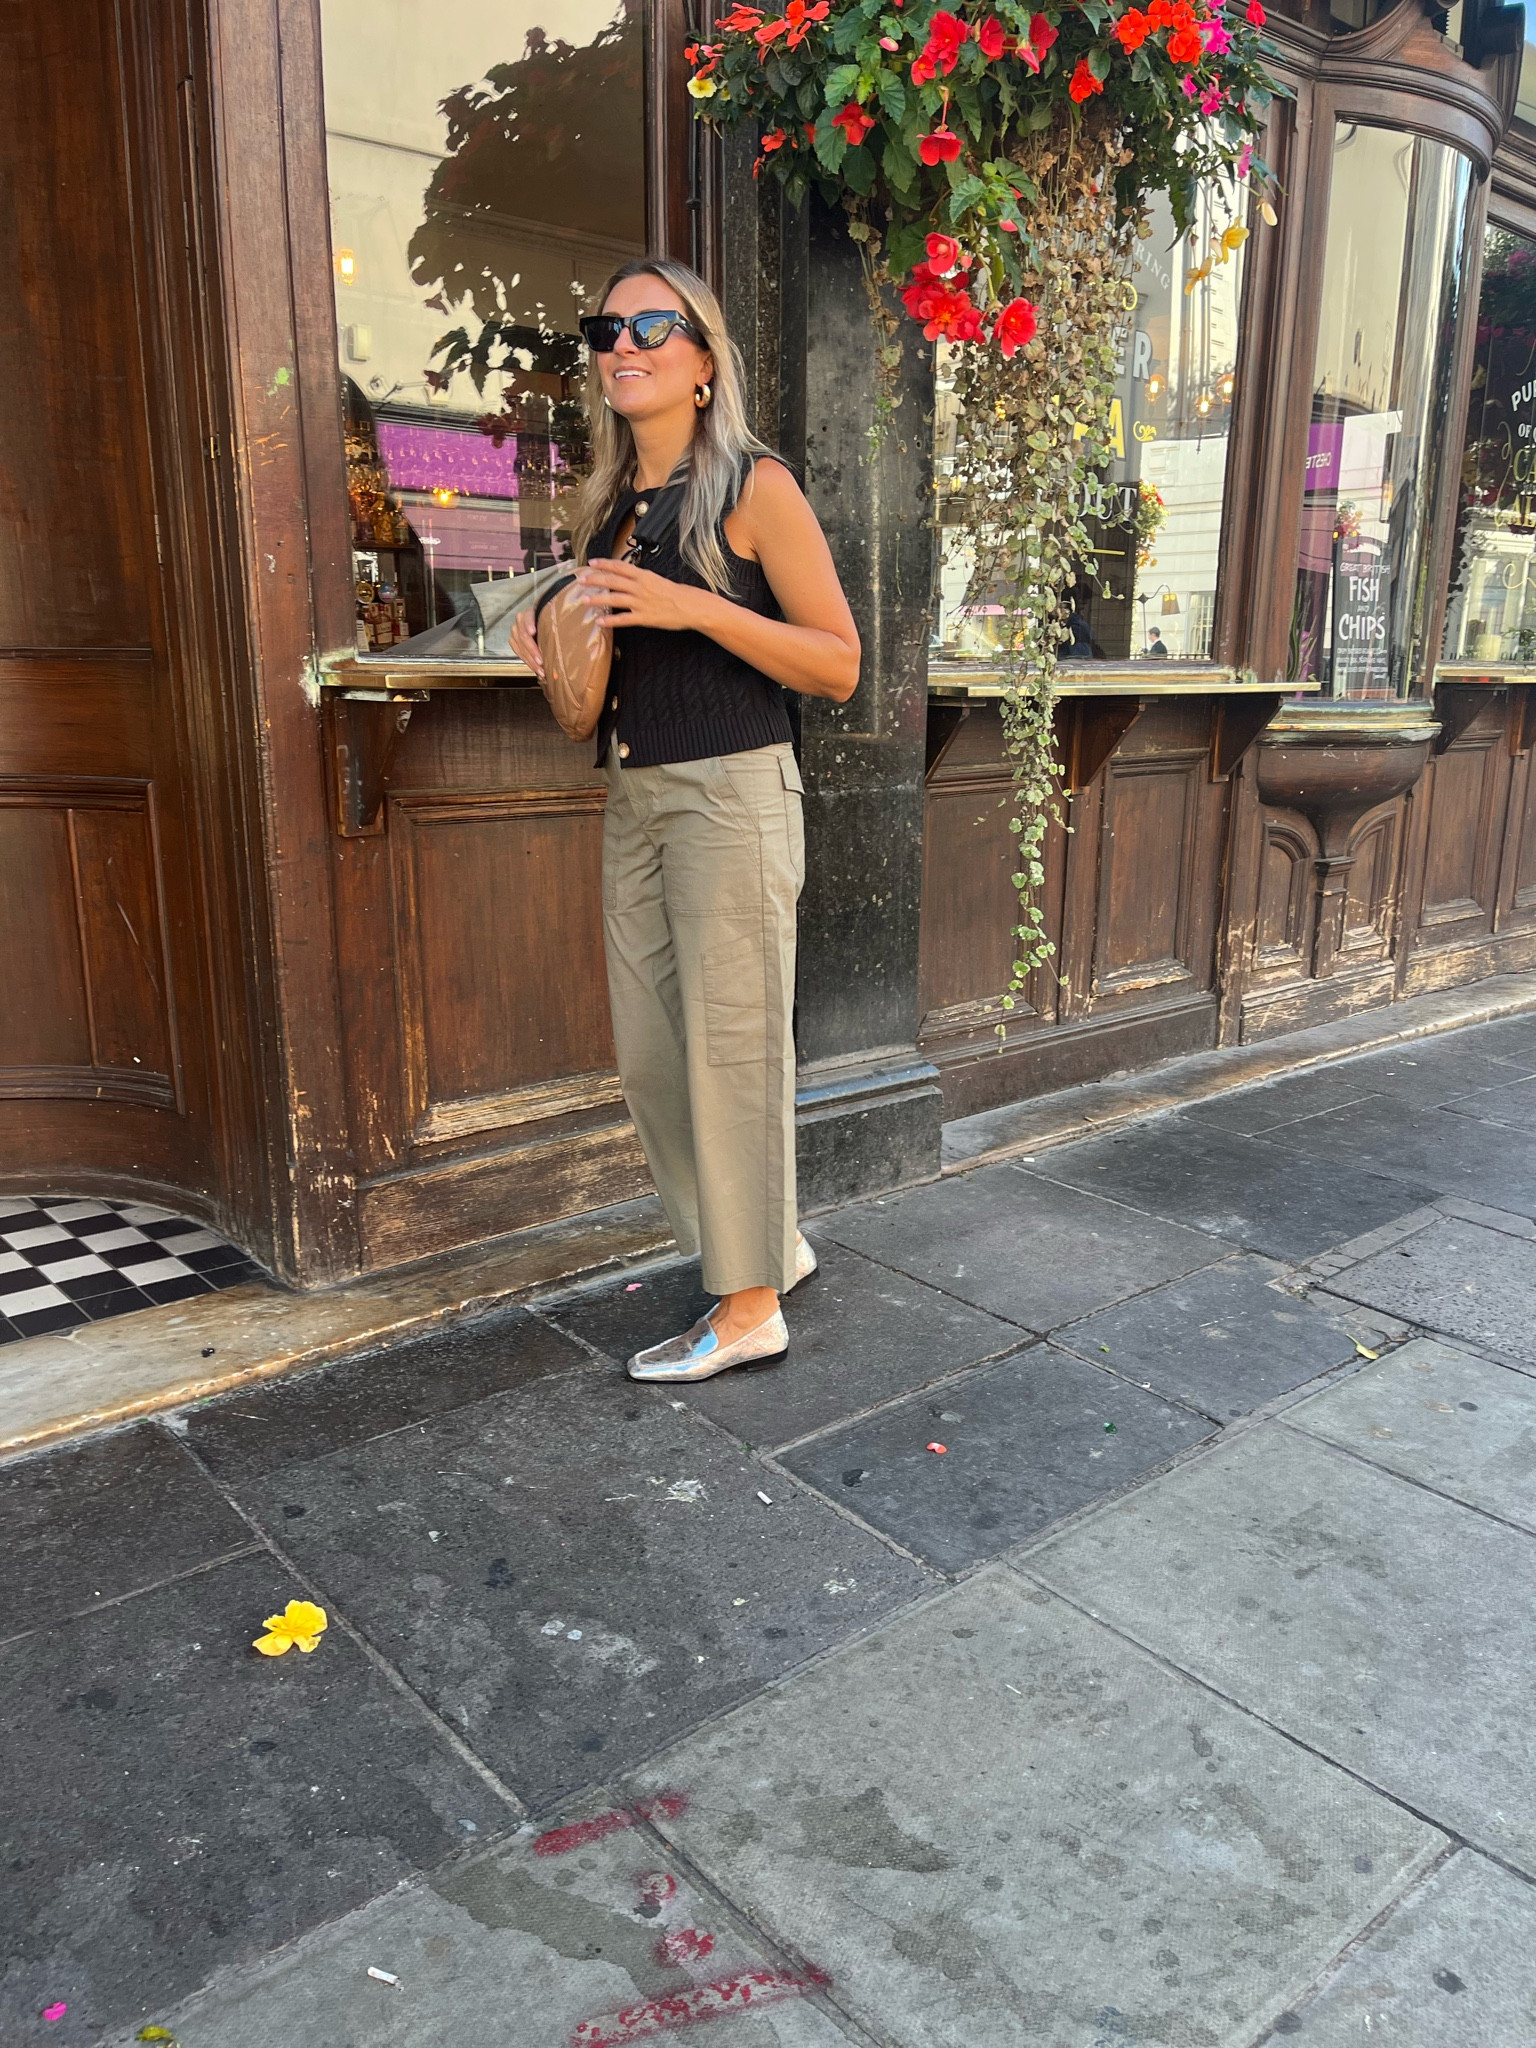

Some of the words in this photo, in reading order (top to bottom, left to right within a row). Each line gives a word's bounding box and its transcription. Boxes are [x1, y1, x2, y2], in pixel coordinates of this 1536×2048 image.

[1511, 379, 1536, 412] PU
[1518, 423, 1532, 438] OF
[1349, 576, 1380, 602] FISH
[1338, 613, 1386, 641] CHIPS
